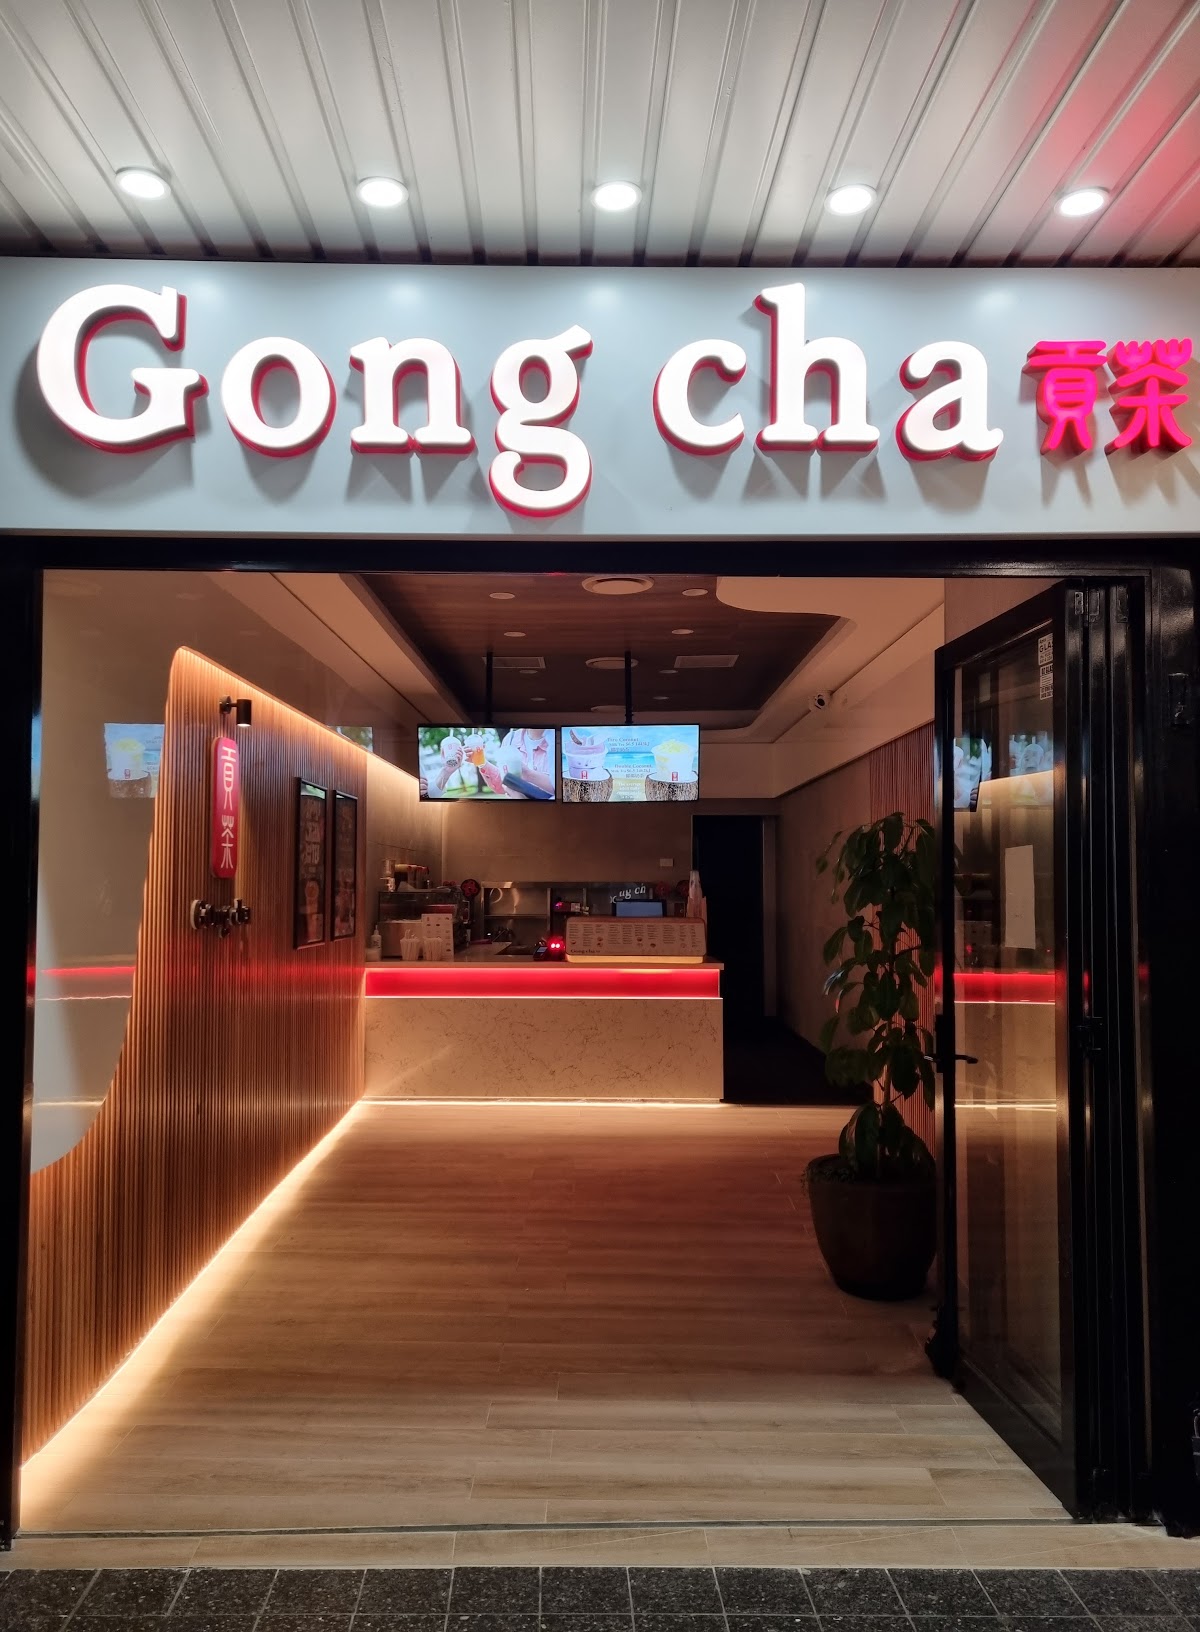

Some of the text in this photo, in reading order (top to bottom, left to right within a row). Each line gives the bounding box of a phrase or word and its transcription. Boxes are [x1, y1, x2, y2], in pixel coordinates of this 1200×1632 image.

[36, 282, 1004, 518] Gong cha
[1023, 338, 1193, 454] 貢茶
